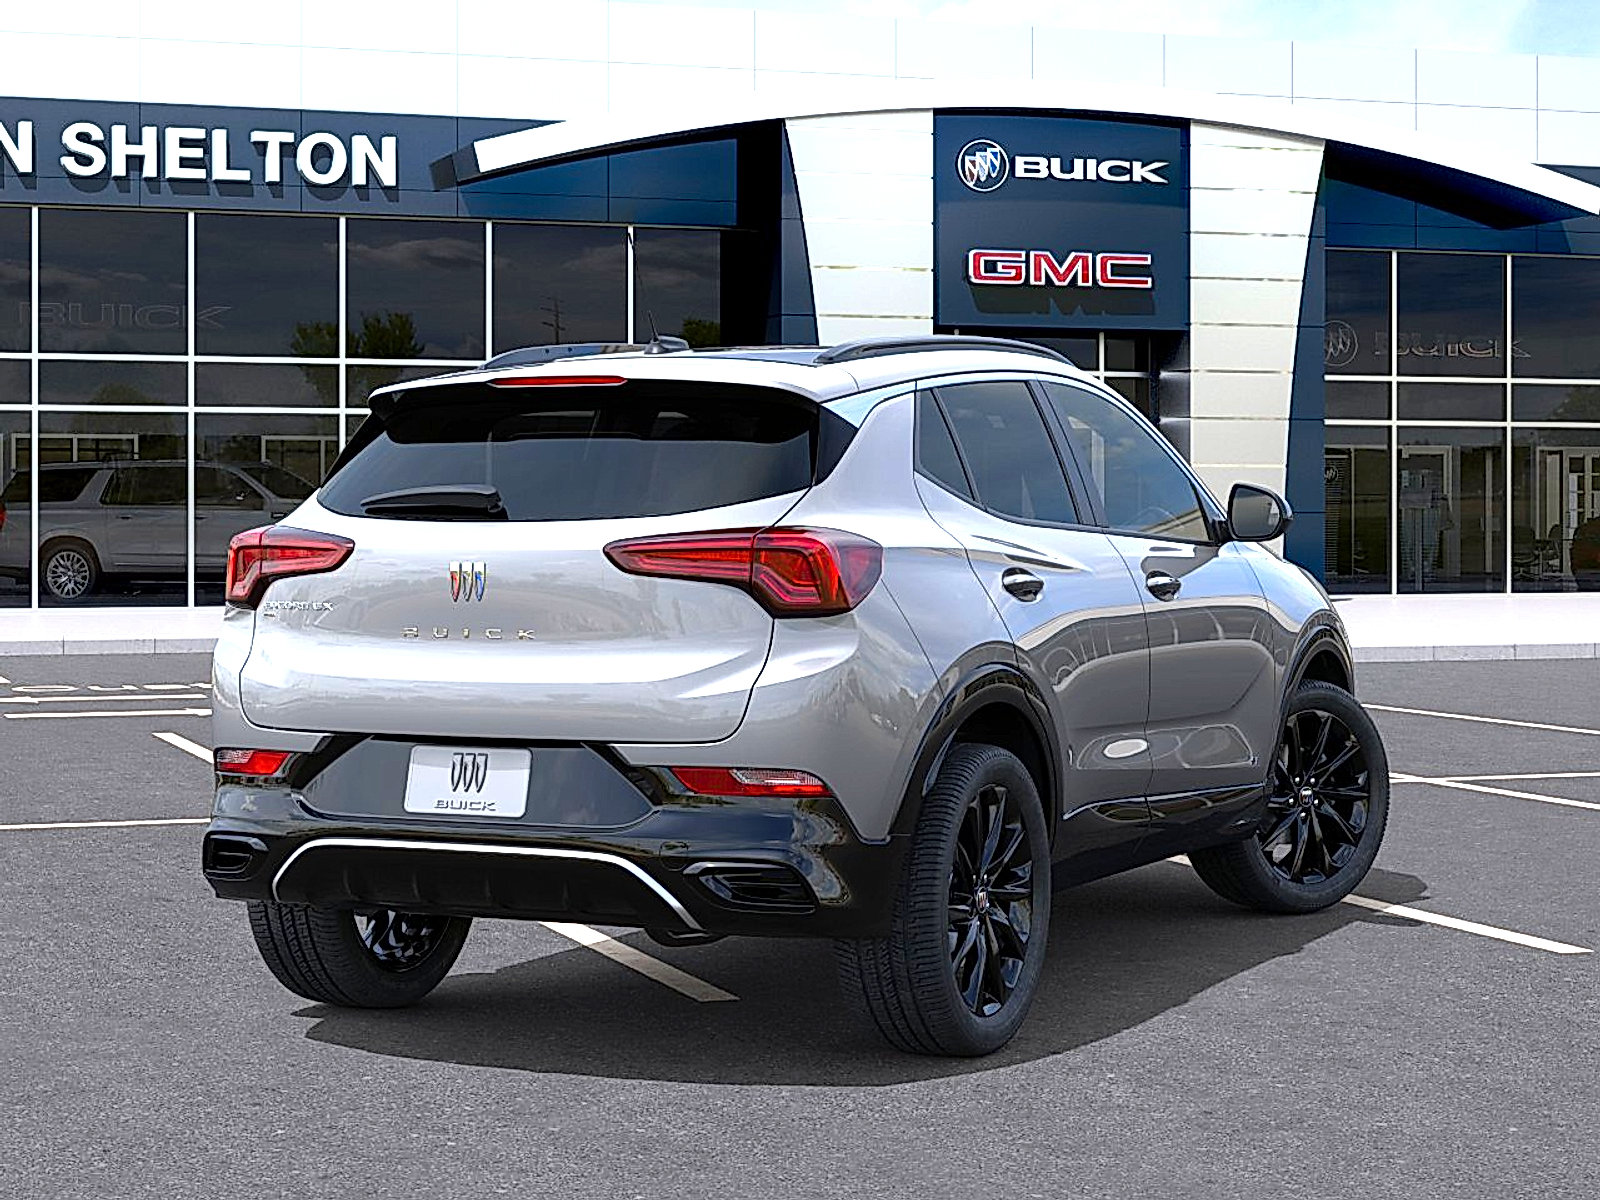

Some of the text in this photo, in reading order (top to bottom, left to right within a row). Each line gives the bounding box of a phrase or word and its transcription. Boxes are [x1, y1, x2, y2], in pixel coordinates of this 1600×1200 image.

[60, 121, 398, 187] SHELTON
[1014, 155, 1170, 184] BUICK
[968, 249, 1153, 288] GMC
[18, 301, 232, 331] BUICK
[401, 626, 536, 641] BUICK
[434, 799, 497, 812] BUICK
